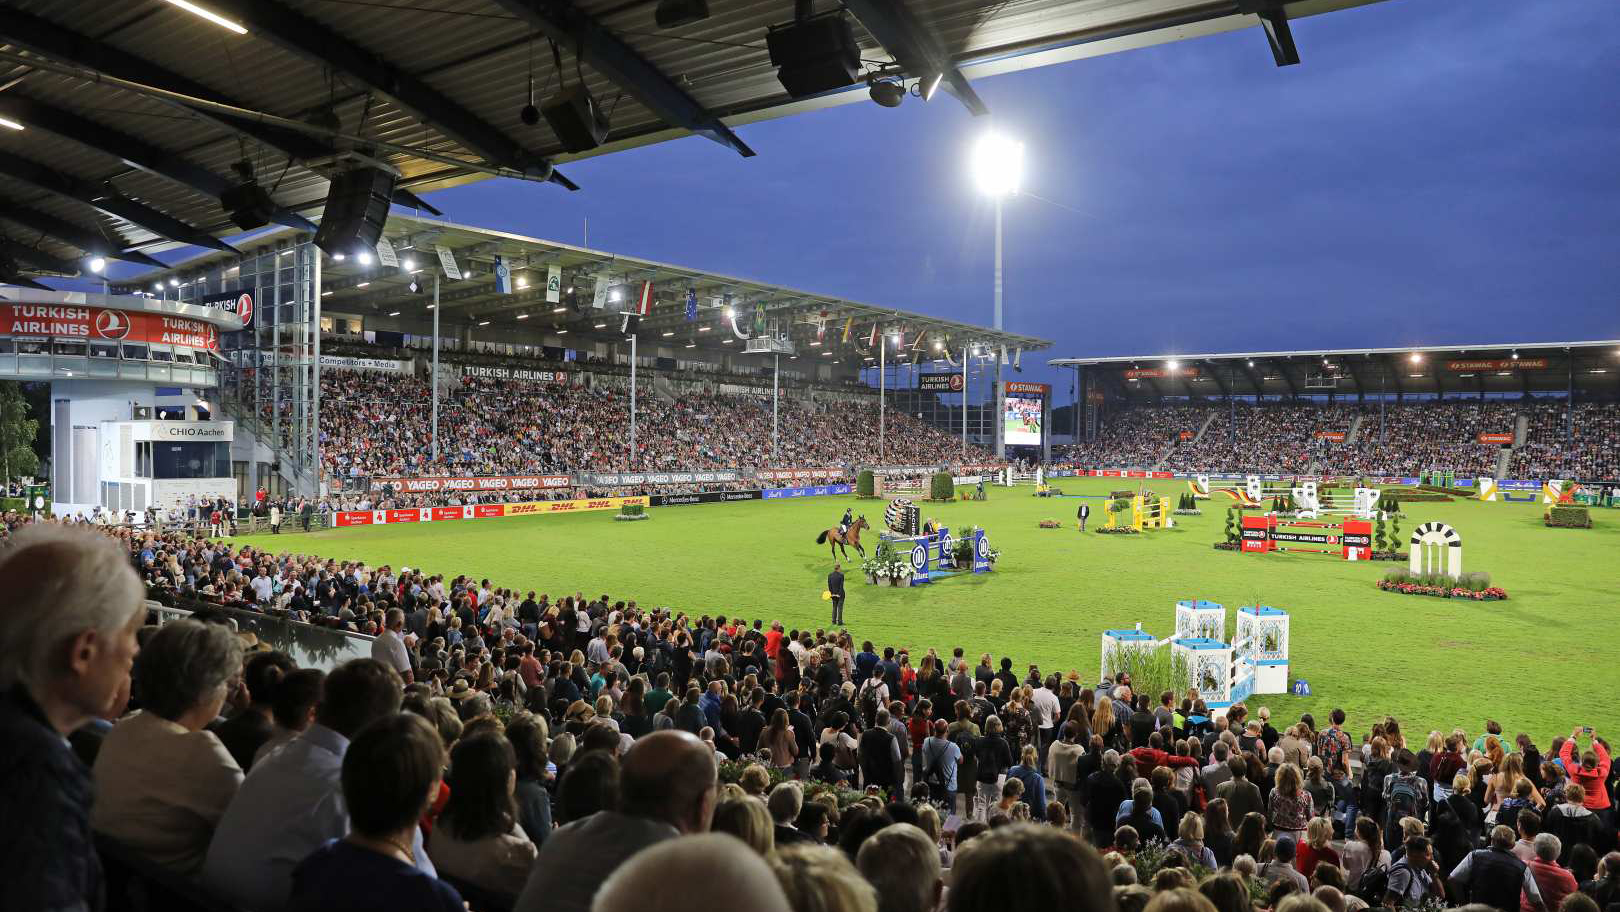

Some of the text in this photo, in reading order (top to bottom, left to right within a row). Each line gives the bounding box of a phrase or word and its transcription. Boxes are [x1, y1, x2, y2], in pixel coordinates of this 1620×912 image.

[12, 306, 90, 320] TURKISH
[12, 321, 90, 336] AIRLINES
[162, 317, 204, 333] TURKISH
[161, 332, 204, 347] AIRLINES
[319, 356, 366, 368] Competitors
[374, 361, 396, 369] Media
[465, 366, 554, 381] TURKISH AIRLINES
[1018, 384, 1043, 392] STAWAG
[169, 427, 225, 436] CHIO Aachen
[406, 480, 440, 491] YAGEO
[443, 479, 475, 489] YAGEO
[479, 478, 508, 488] YAGEO
[511, 478, 539, 487] YAGEO
[543, 477, 569, 487] YAGEO
[622, 475, 645, 484] YAGEO
[648, 474, 669, 483] YAGEO
[672, 474, 693, 482] YAGEO
[695, 473, 714, 482] YAGEO
[717, 472, 736, 481] YAGEO
[511, 505, 537, 513] DHL
